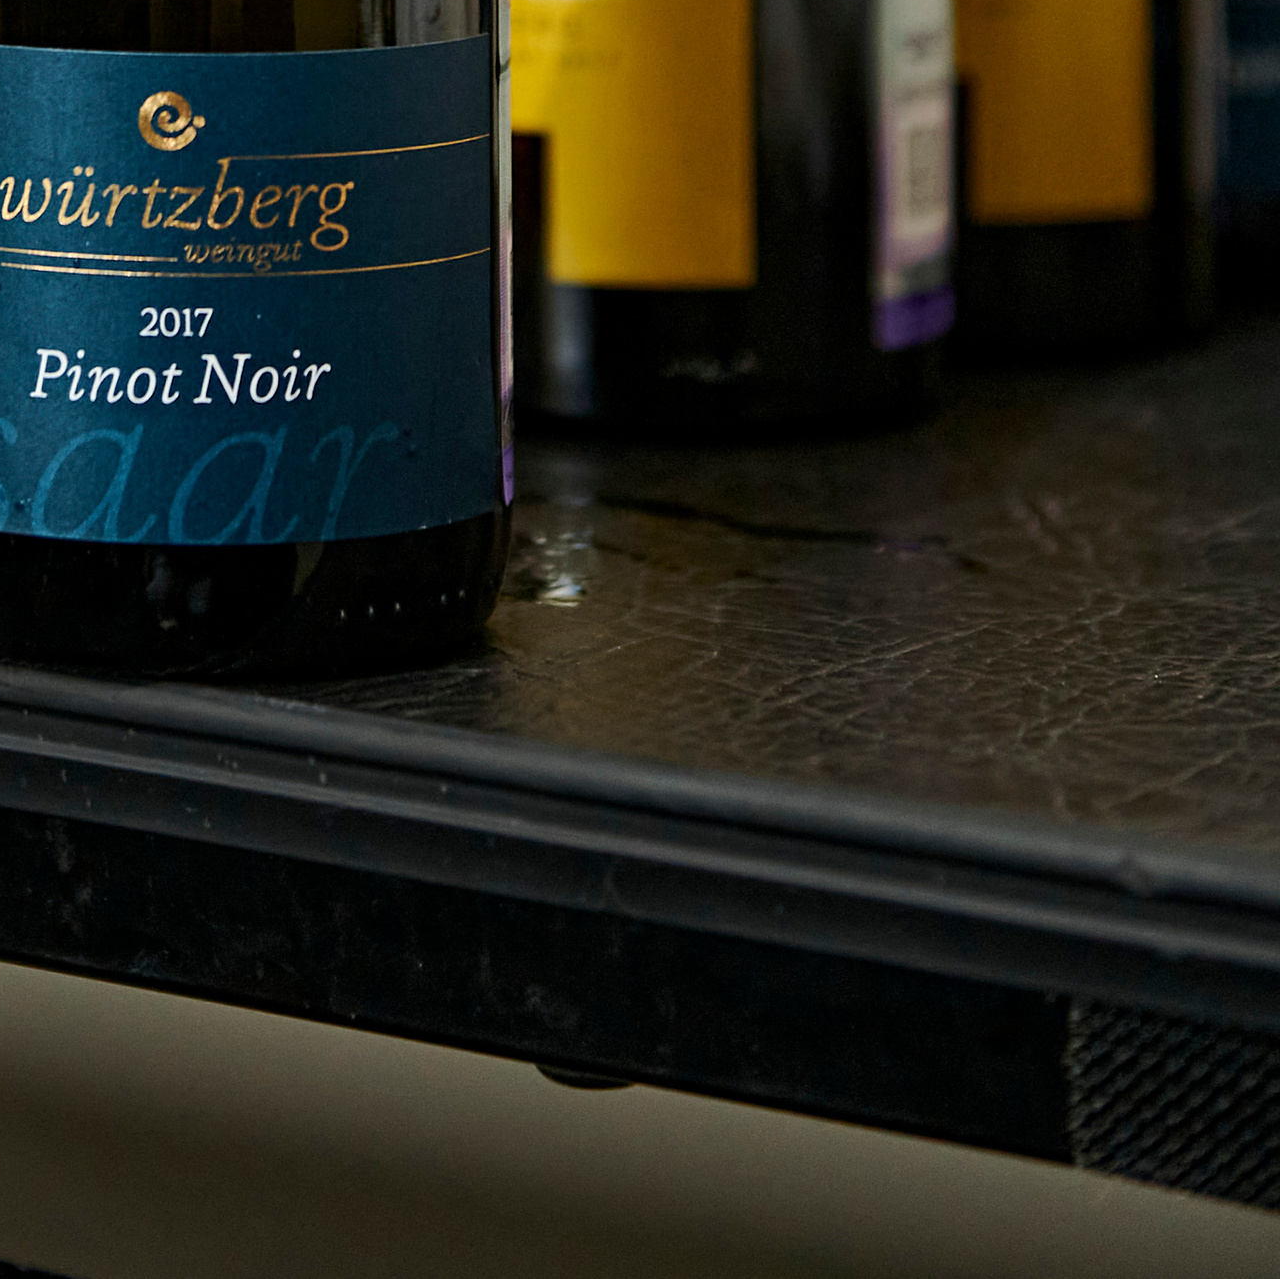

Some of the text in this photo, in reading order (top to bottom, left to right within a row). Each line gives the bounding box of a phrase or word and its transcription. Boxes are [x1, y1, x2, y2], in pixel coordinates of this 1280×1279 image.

[0, 158, 355, 250] würtzberg
[183, 237, 302, 272] weingut
[139, 306, 214, 338] 2017
[29, 348, 331, 405] Pinot Noir
